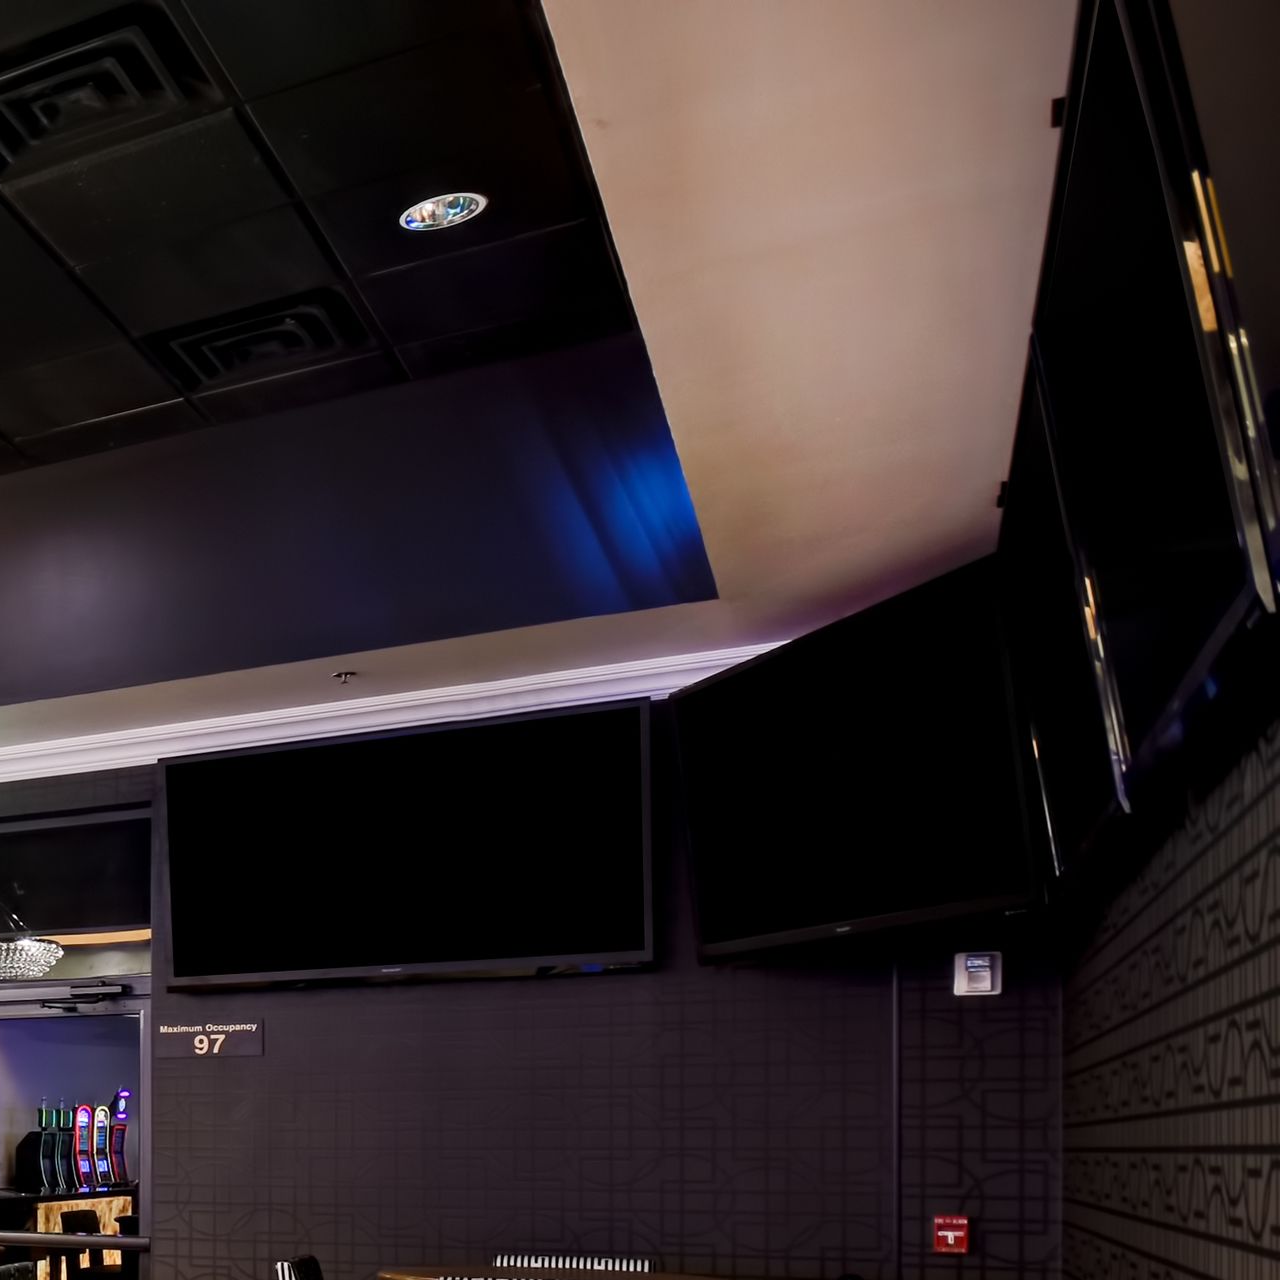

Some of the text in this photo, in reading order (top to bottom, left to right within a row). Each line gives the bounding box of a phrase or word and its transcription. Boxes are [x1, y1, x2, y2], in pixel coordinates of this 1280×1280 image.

[160, 1023, 258, 1033] Maximum Occupancy
[193, 1034, 226, 1055] 97
